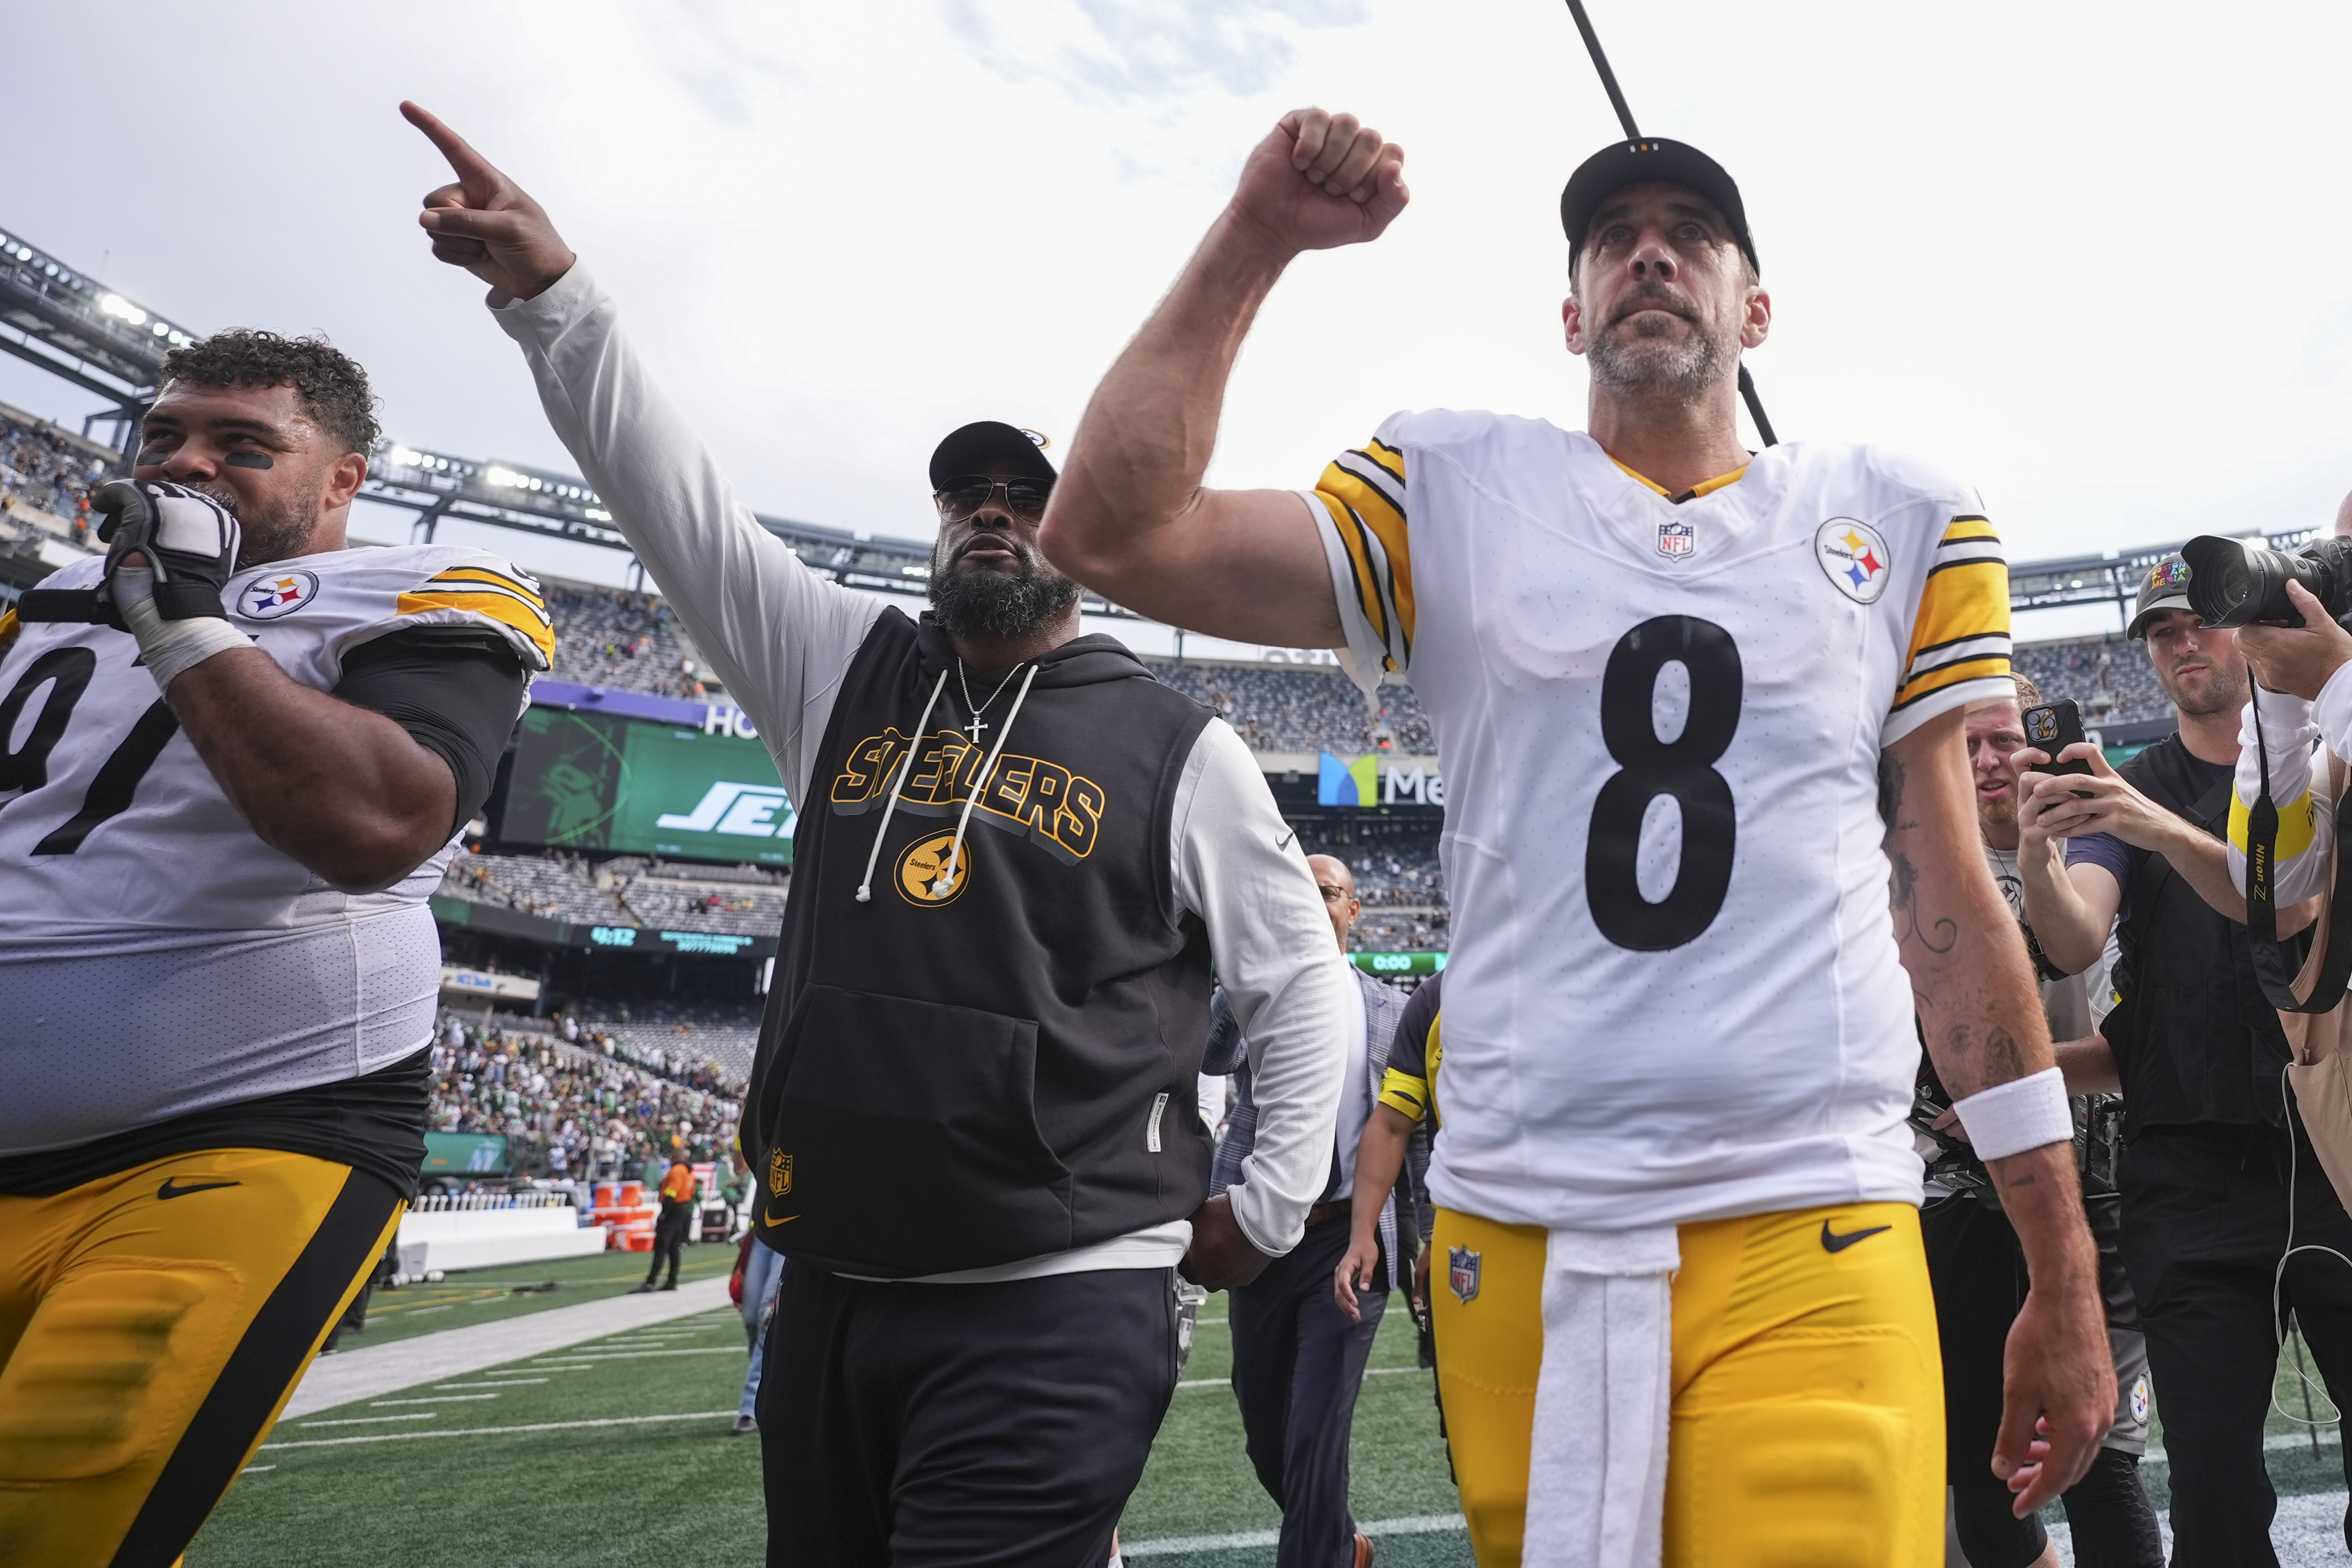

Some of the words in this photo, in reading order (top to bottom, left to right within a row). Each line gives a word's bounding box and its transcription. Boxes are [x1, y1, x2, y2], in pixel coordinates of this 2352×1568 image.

[1663, 537, 1689, 552] NFL
[831, 727, 1106, 858] STEELERS
[1585, 614, 1743, 951] 8
[909, 858, 937, 871] Steelers
[2256, 843, 2265, 882] Nikon
[1373, 955, 1412, 970] 0:00
[770, 1167, 788, 1191] NFL
[1453, 1270, 1473, 1292] NFL
